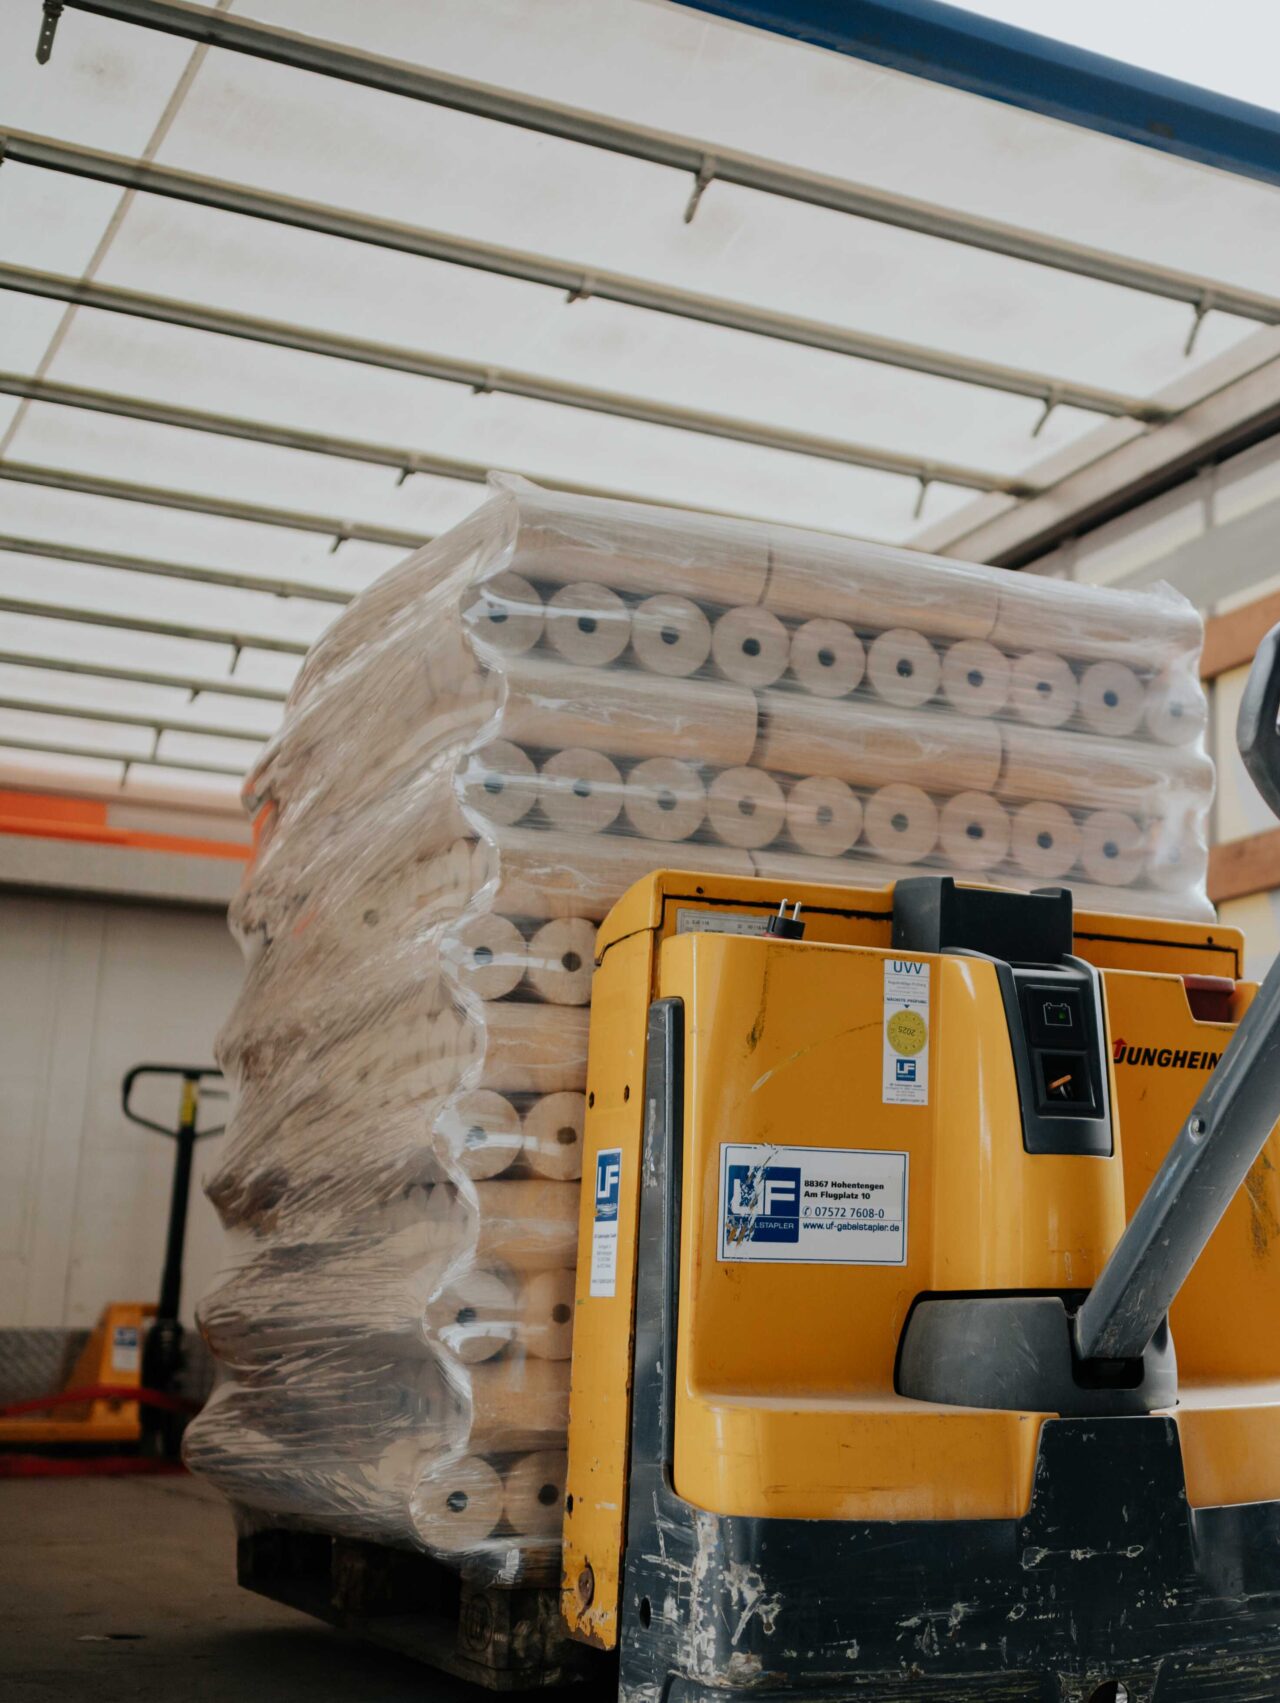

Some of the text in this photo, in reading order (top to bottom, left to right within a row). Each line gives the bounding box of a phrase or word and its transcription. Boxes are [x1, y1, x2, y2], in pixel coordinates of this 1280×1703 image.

[893, 961, 922, 974] UVV
[1113, 1046, 1223, 1070] JUNGHEIN
[804, 1180, 885, 1191] 88367 Hohentengen
[803, 1190, 871, 1200] Am Flugplatz 10
[814, 1206, 885, 1219] 07572 7608-0
[803, 1221, 899, 1232] www.uf-gabelstapler.de
